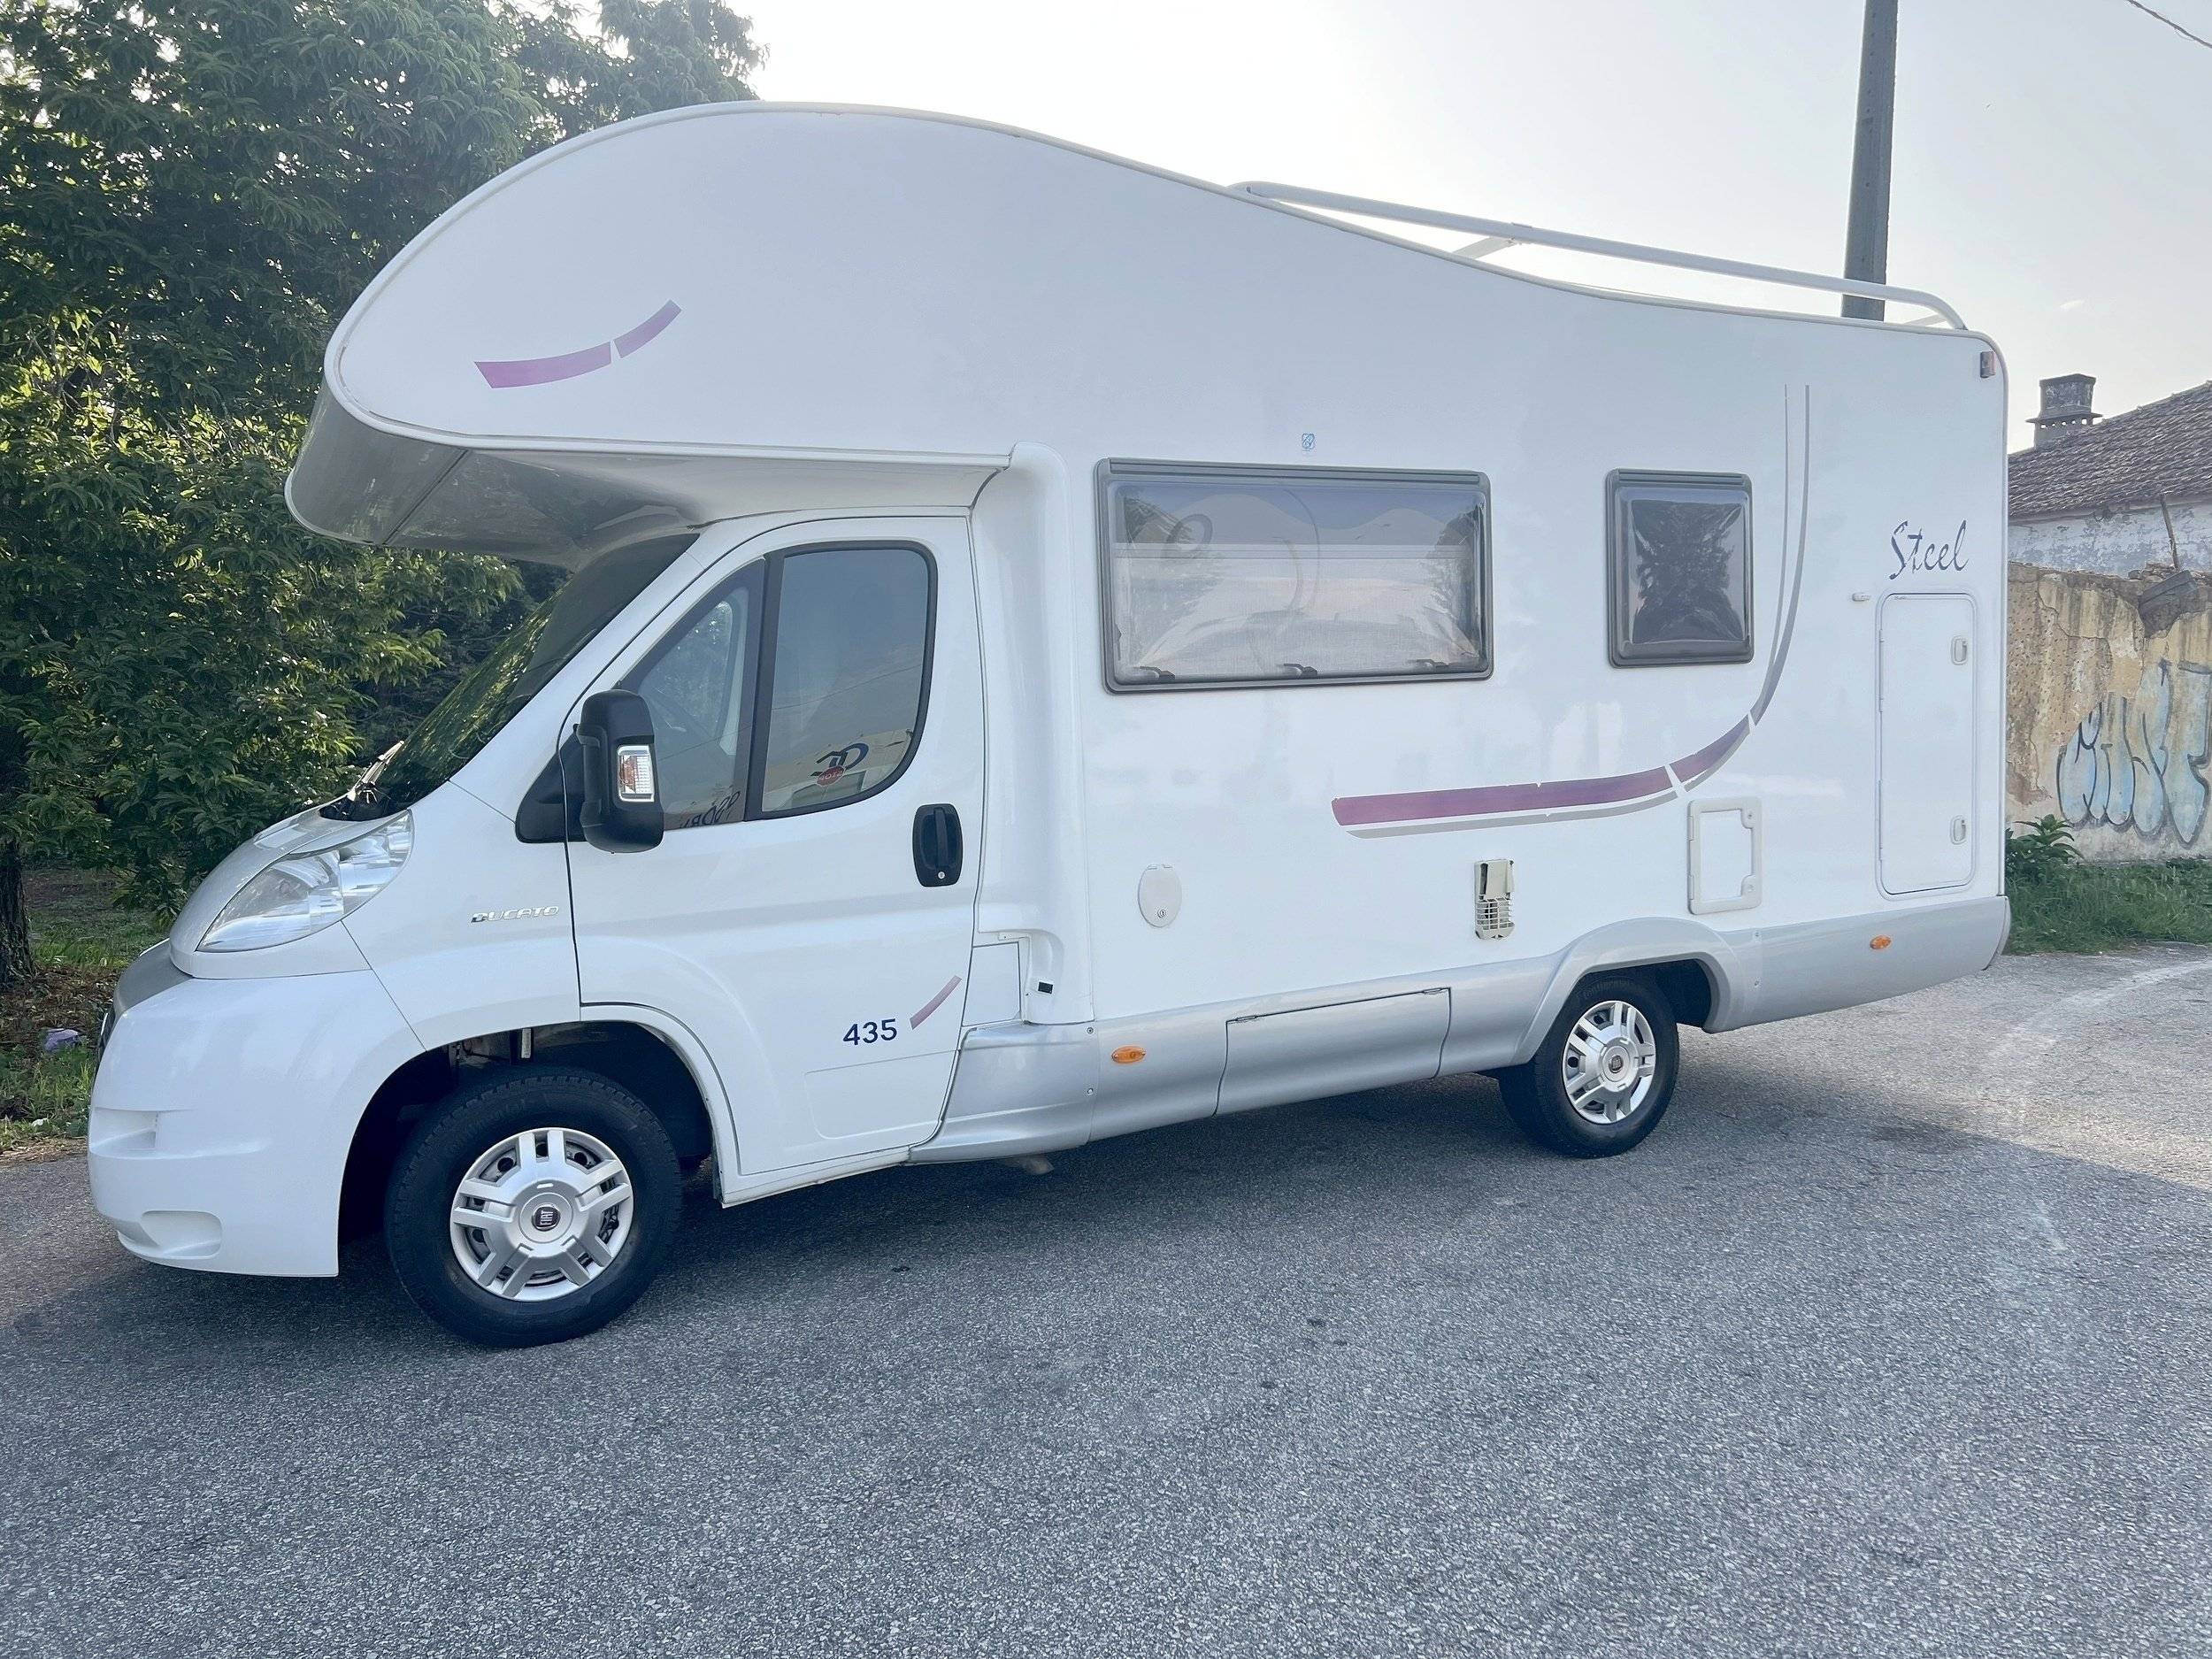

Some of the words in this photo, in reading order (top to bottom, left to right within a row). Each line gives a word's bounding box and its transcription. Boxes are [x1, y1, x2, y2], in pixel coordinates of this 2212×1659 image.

[1889, 519, 1970, 580] Steel
[470, 905, 560, 924] DUCATO
[842, 1018, 898, 1046] 435
[540, 1210, 554, 1225] FIAT
